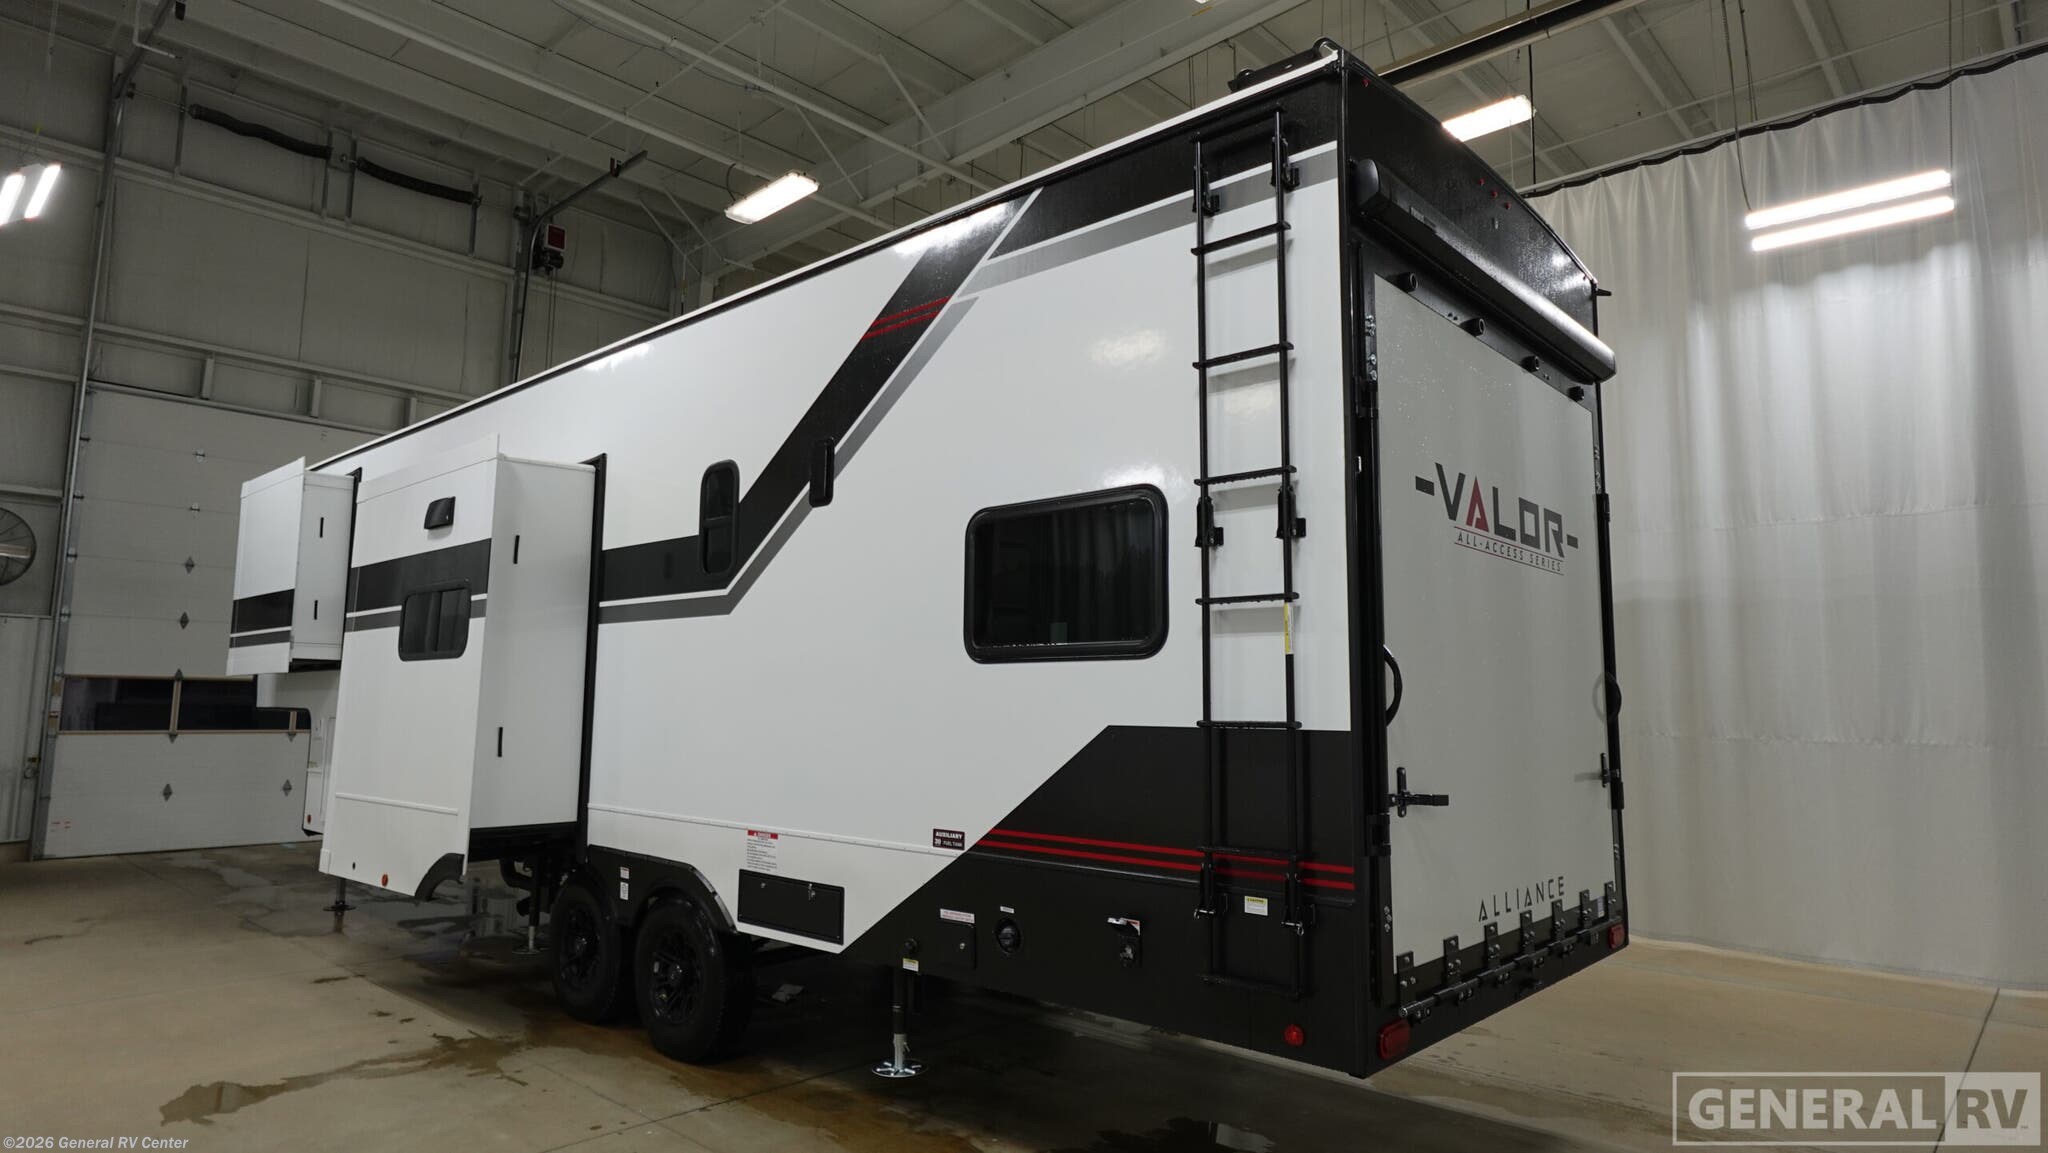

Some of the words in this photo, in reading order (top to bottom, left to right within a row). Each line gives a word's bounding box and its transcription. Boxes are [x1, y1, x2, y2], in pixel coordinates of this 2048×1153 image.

[1458, 531, 1524, 560] ALL-ACCESS
[1529, 553, 1561, 572] SERIES
[935, 831, 962, 839] AUXILIARY
[1478, 876, 1564, 922] ALLIANCE
